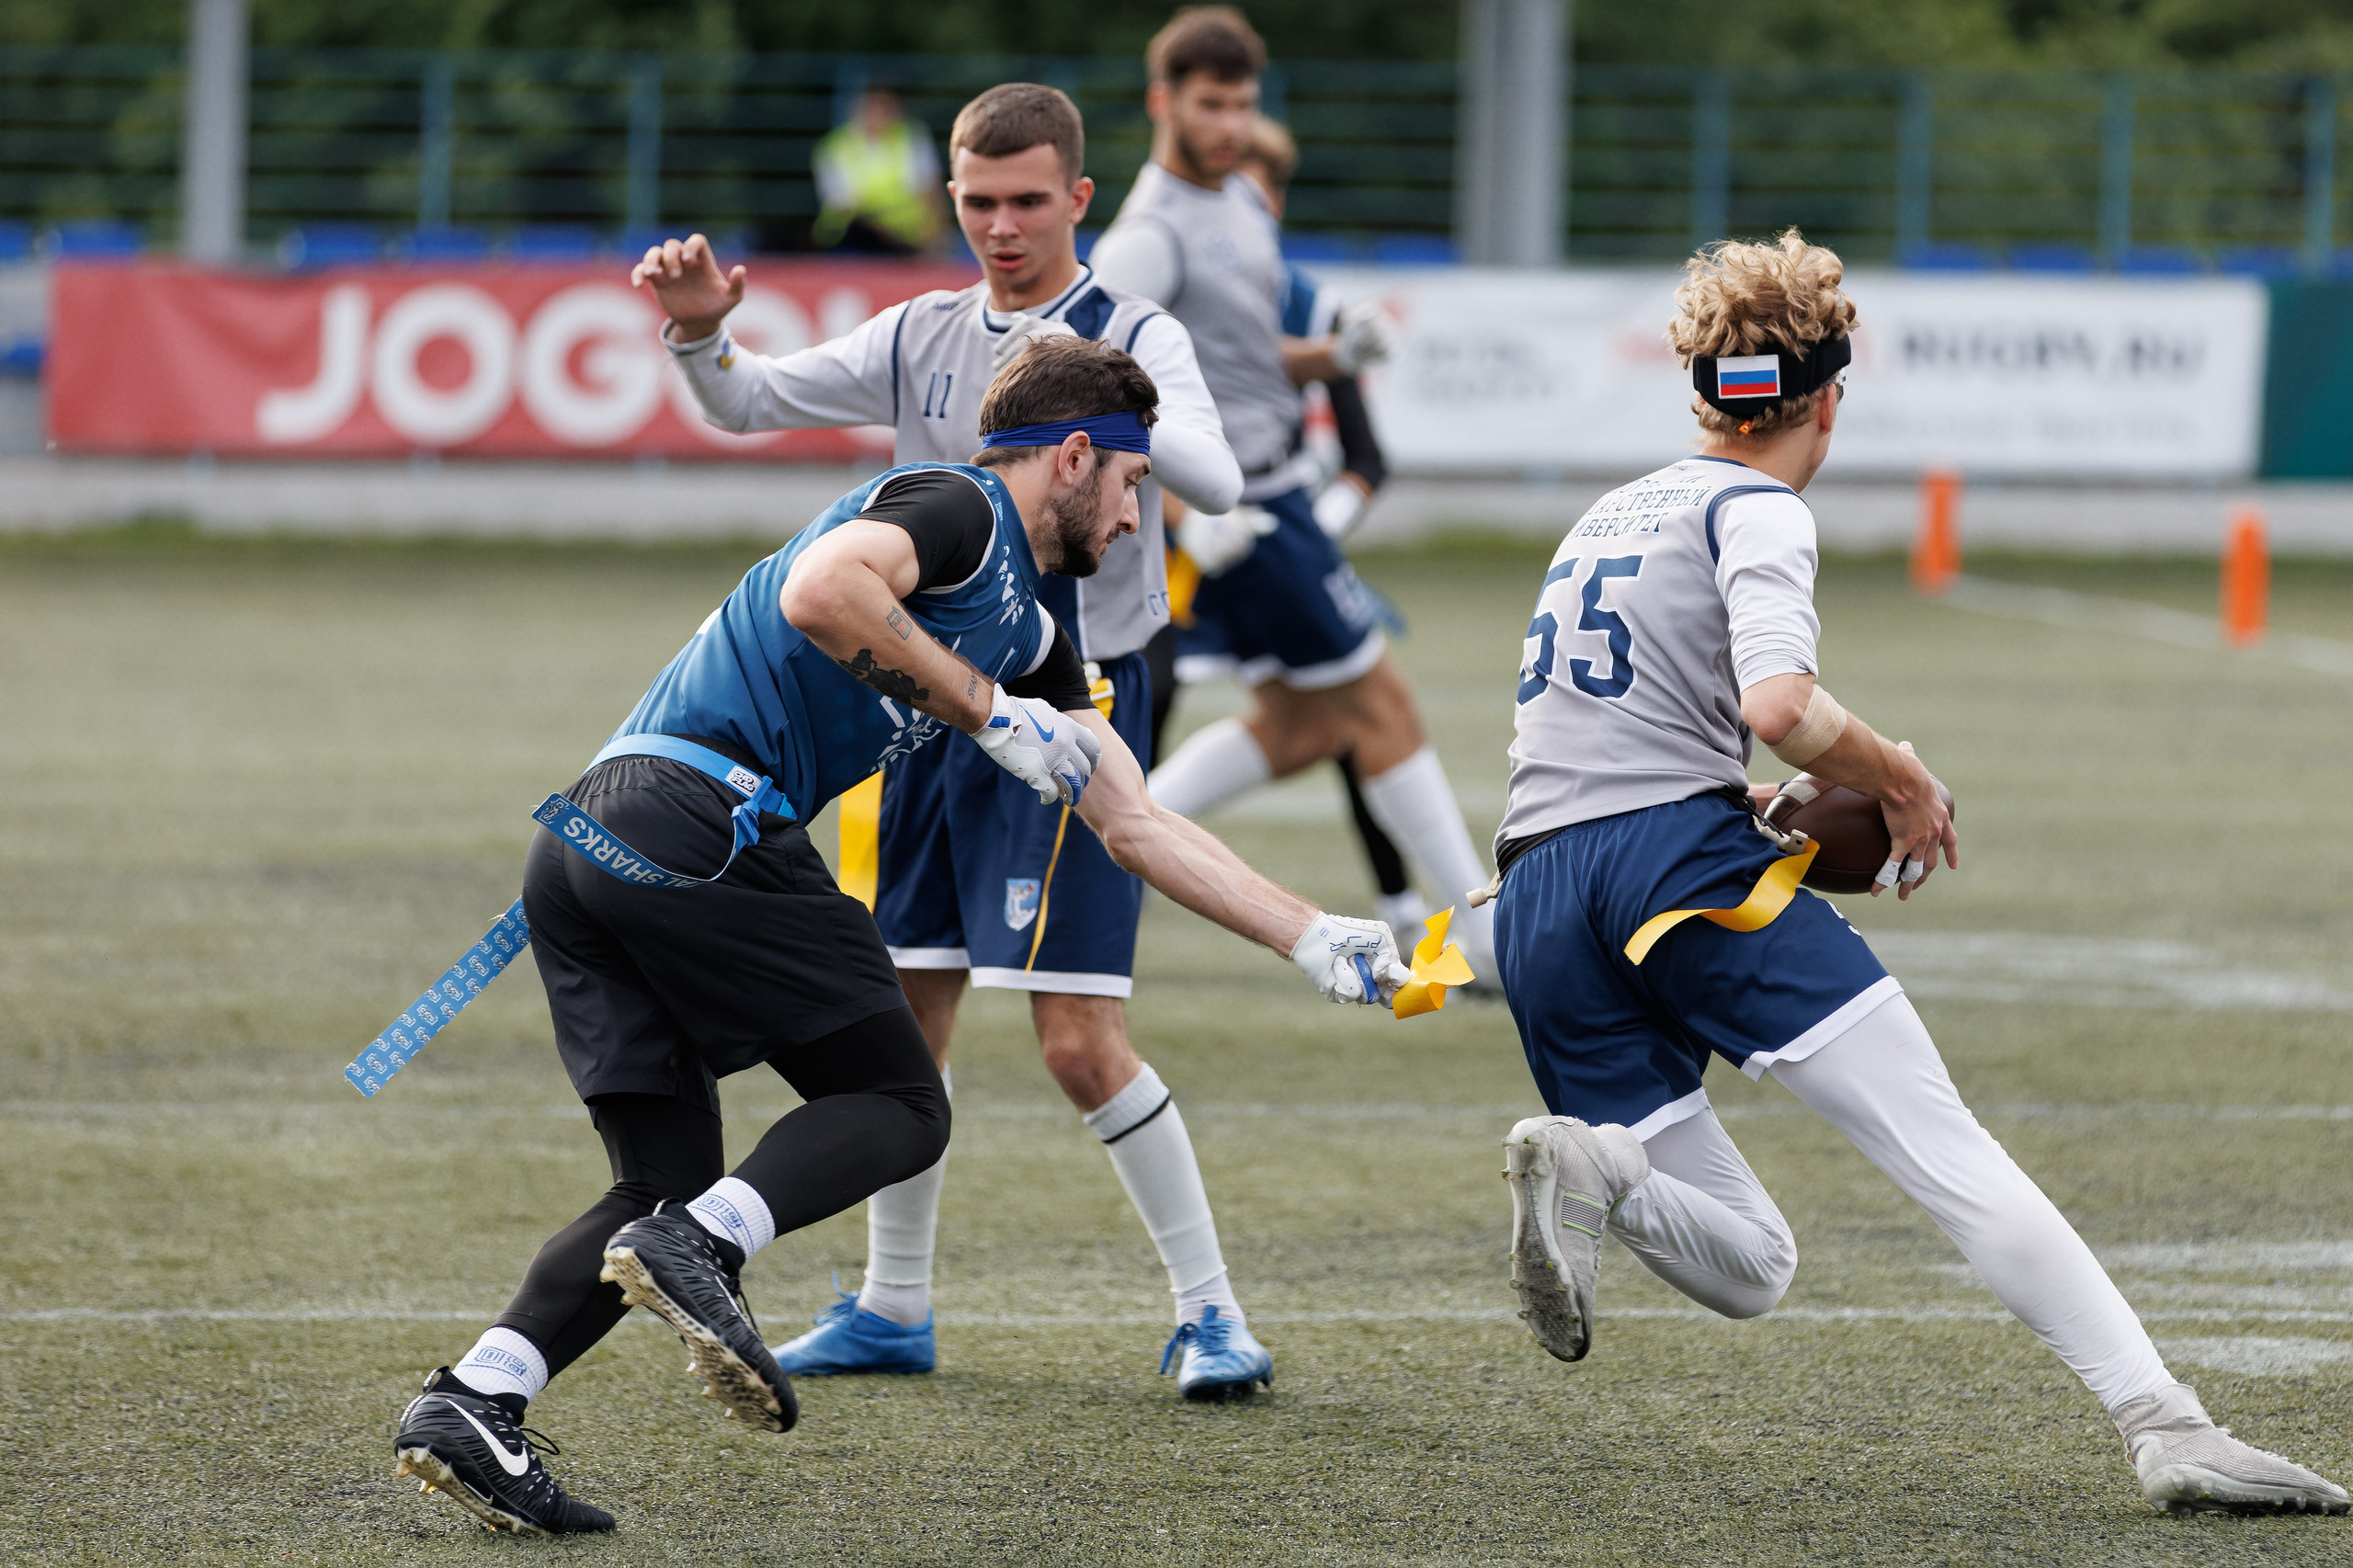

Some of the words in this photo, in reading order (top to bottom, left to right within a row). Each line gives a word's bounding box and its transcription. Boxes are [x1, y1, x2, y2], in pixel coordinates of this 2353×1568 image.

[257, 283, 896, 452] JOG
[922, 369, 955, 421] 11
[1516, 554, 1645, 706] 55
[731, 776, 756, 792] FLAG
[563, 815, 665, 885] SHARKS
